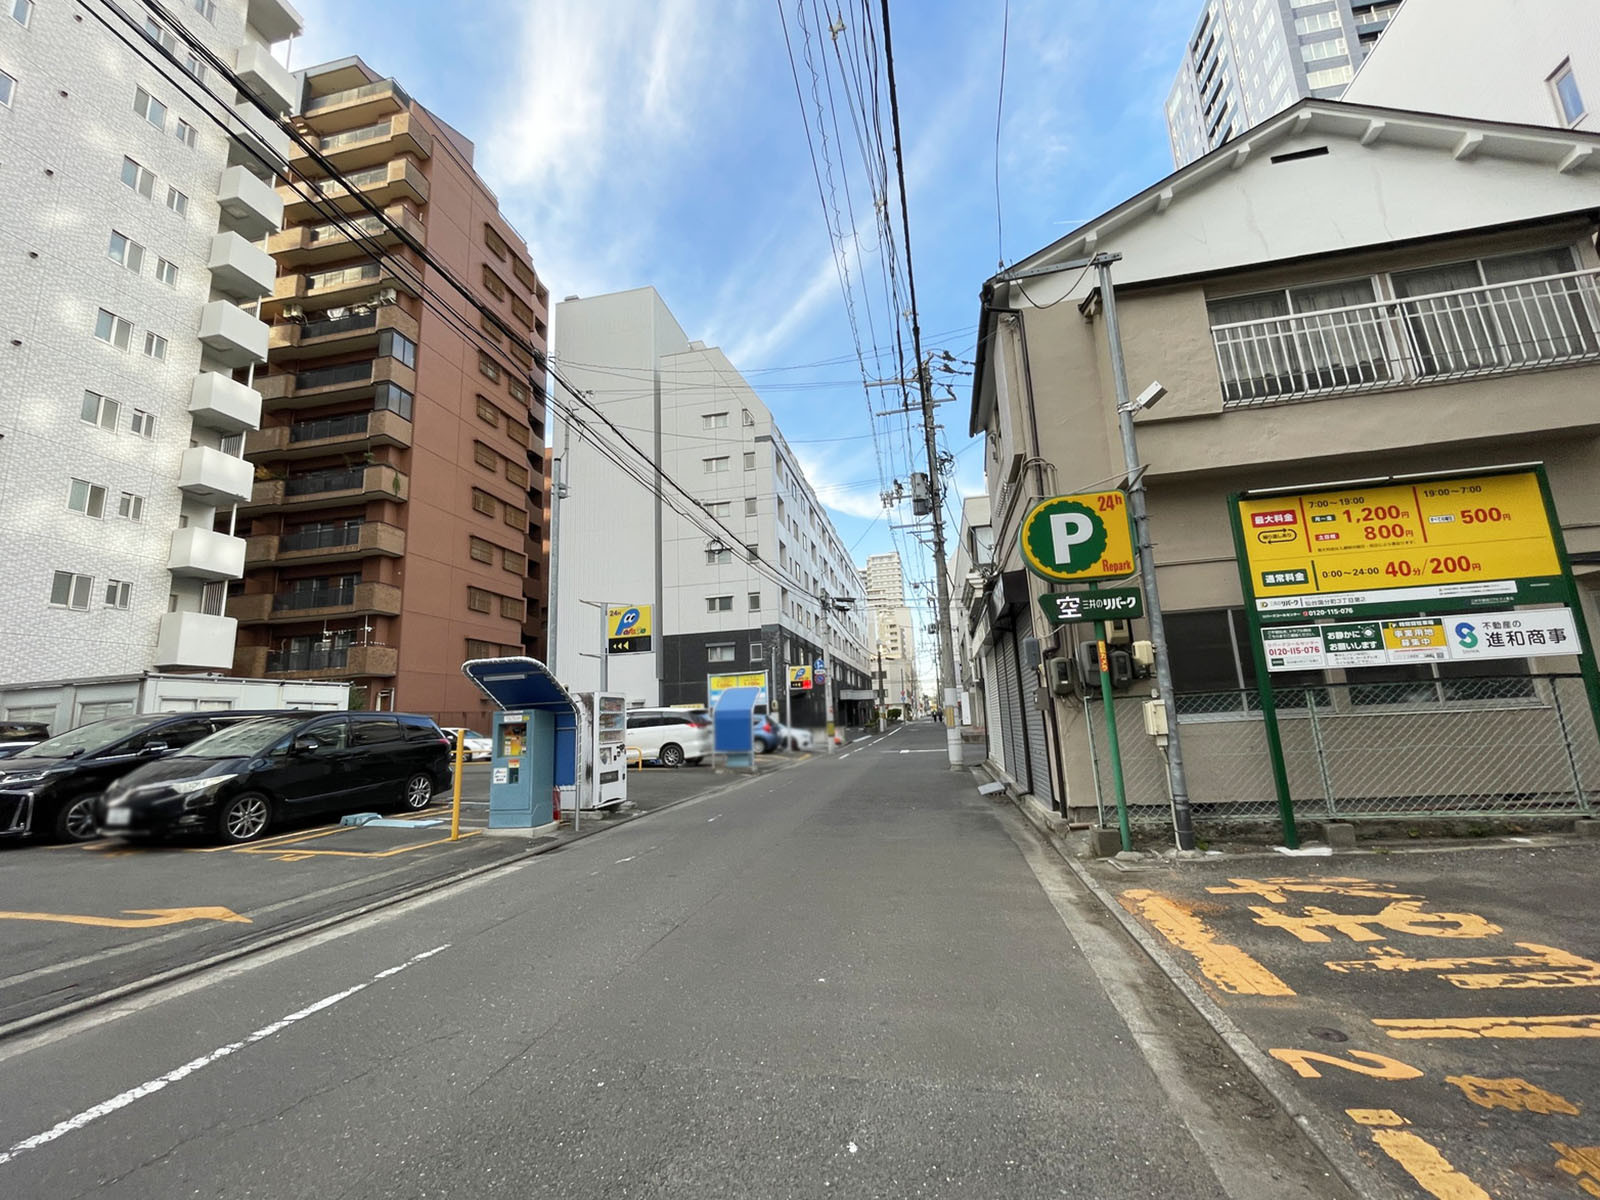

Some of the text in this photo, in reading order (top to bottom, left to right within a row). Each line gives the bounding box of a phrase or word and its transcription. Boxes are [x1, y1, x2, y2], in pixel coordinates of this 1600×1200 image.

[1423, 485, 1482, 498] 19:00～7:00
[1097, 494, 1123, 512] 24h
[1254, 512, 1294, 525] 最大料金
[1342, 505, 1410, 524] 1,200円
[1460, 507, 1512, 525] 500円
[1049, 512, 1094, 565] P
[1364, 524, 1414, 541] 800円
[1102, 559, 1132, 573] Repark
[1264, 572, 1305, 584] 通常料金
[1056, 596, 1136, 619] 空 三井のリパーク
[1482, 620, 1522, 630] 不動産の
[1485, 628, 1567, 648] 進和商事
[1268, 646, 1321, 656] 0120-115-076
